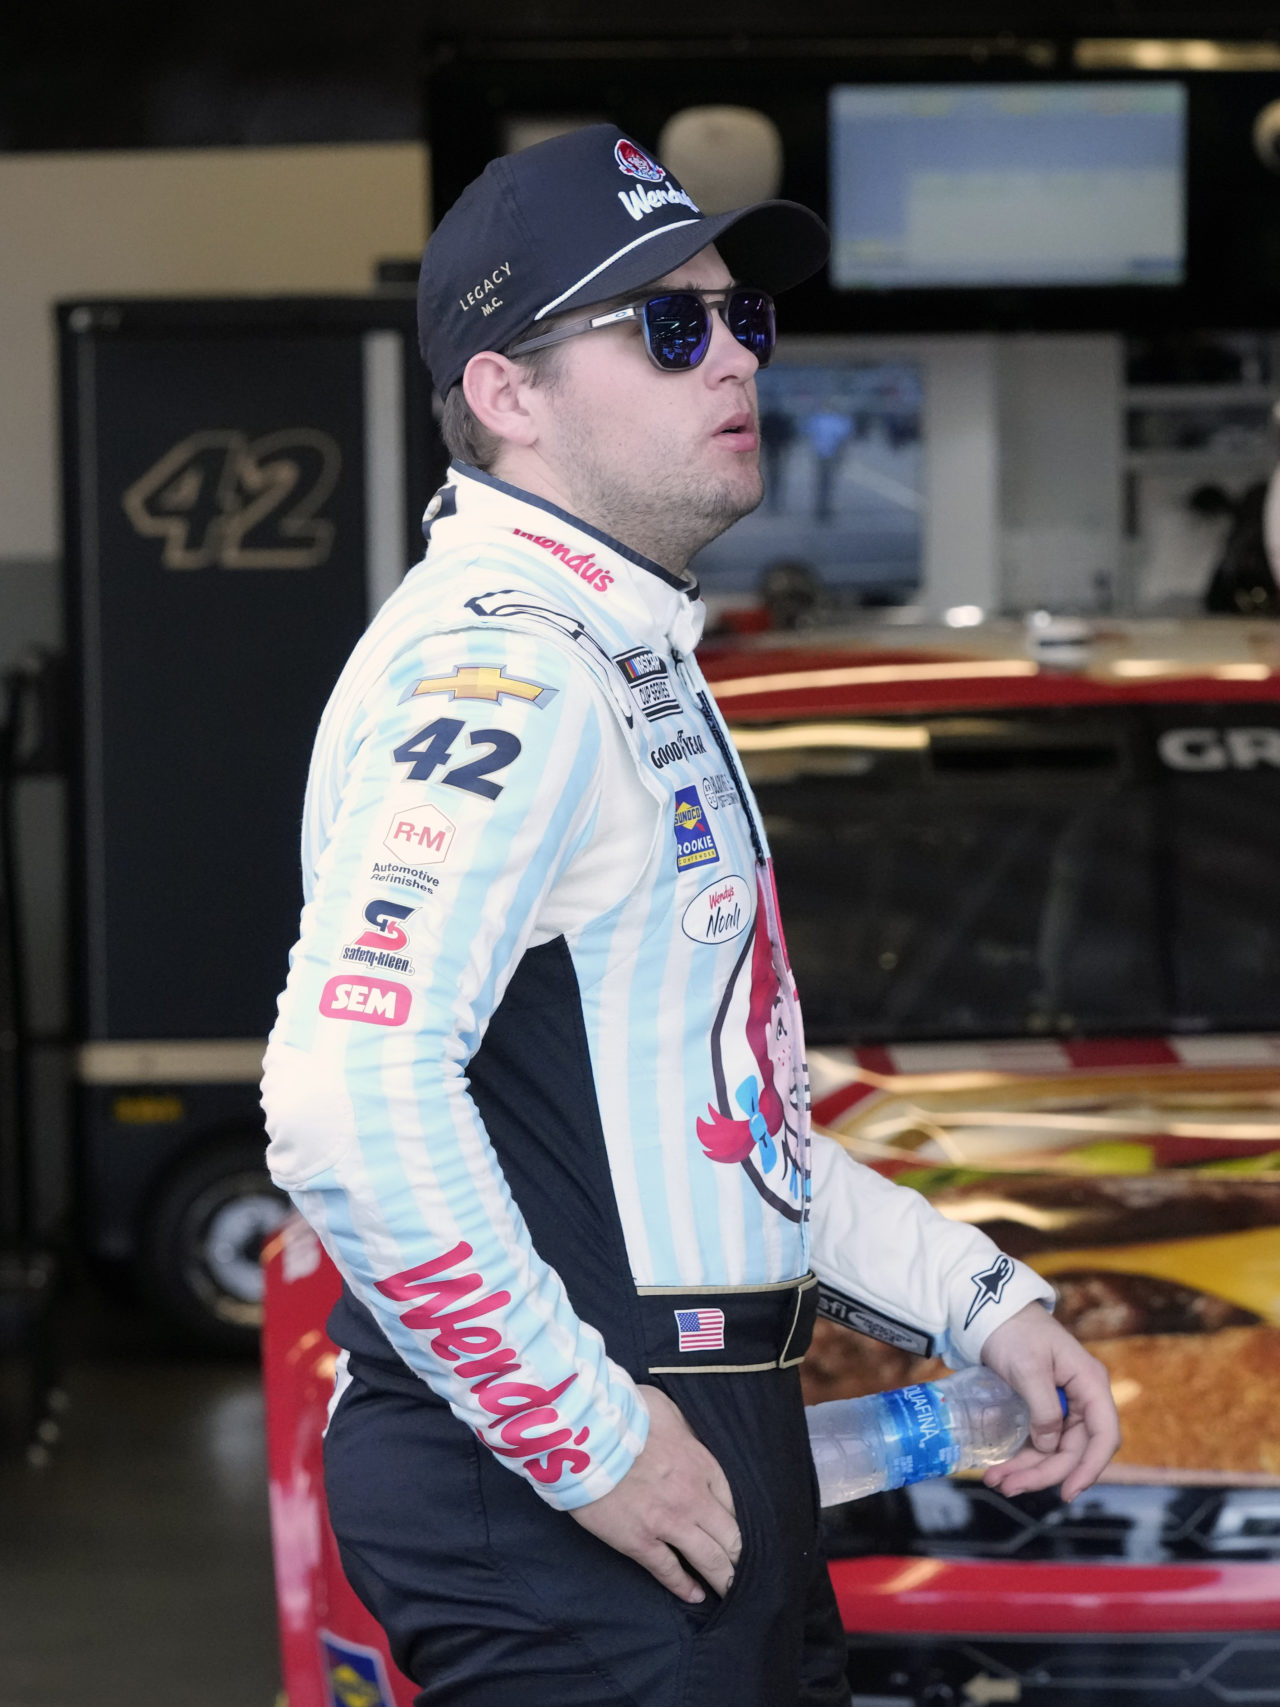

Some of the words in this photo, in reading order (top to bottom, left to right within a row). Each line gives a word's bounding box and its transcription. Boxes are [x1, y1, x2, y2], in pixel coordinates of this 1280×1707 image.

[460, 262, 511, 311] LEGACY
[481, 297, 503, 316] M.C.
[120, 427, 342, 570] 42
[639, 685, 651, 706] CUP
[650, 681, 671, 702] SERIES
[393, 717, 522, 801] 42
[675, 807, 701, 825] SUNOCO
[393, 821, 446, 852] R-M
[677, 835, 714, 855] ROOKIE
[370, 873, 434, 895] Refinishes
[372, 862, 440, 887] Automotive
[706, 902, 741, 938] Noah
[331, 983, 397, 1019] SEM
[374, 1241, 590, 1484] Wendy's
[902, 1384, 940, 1442] QUAFINA
